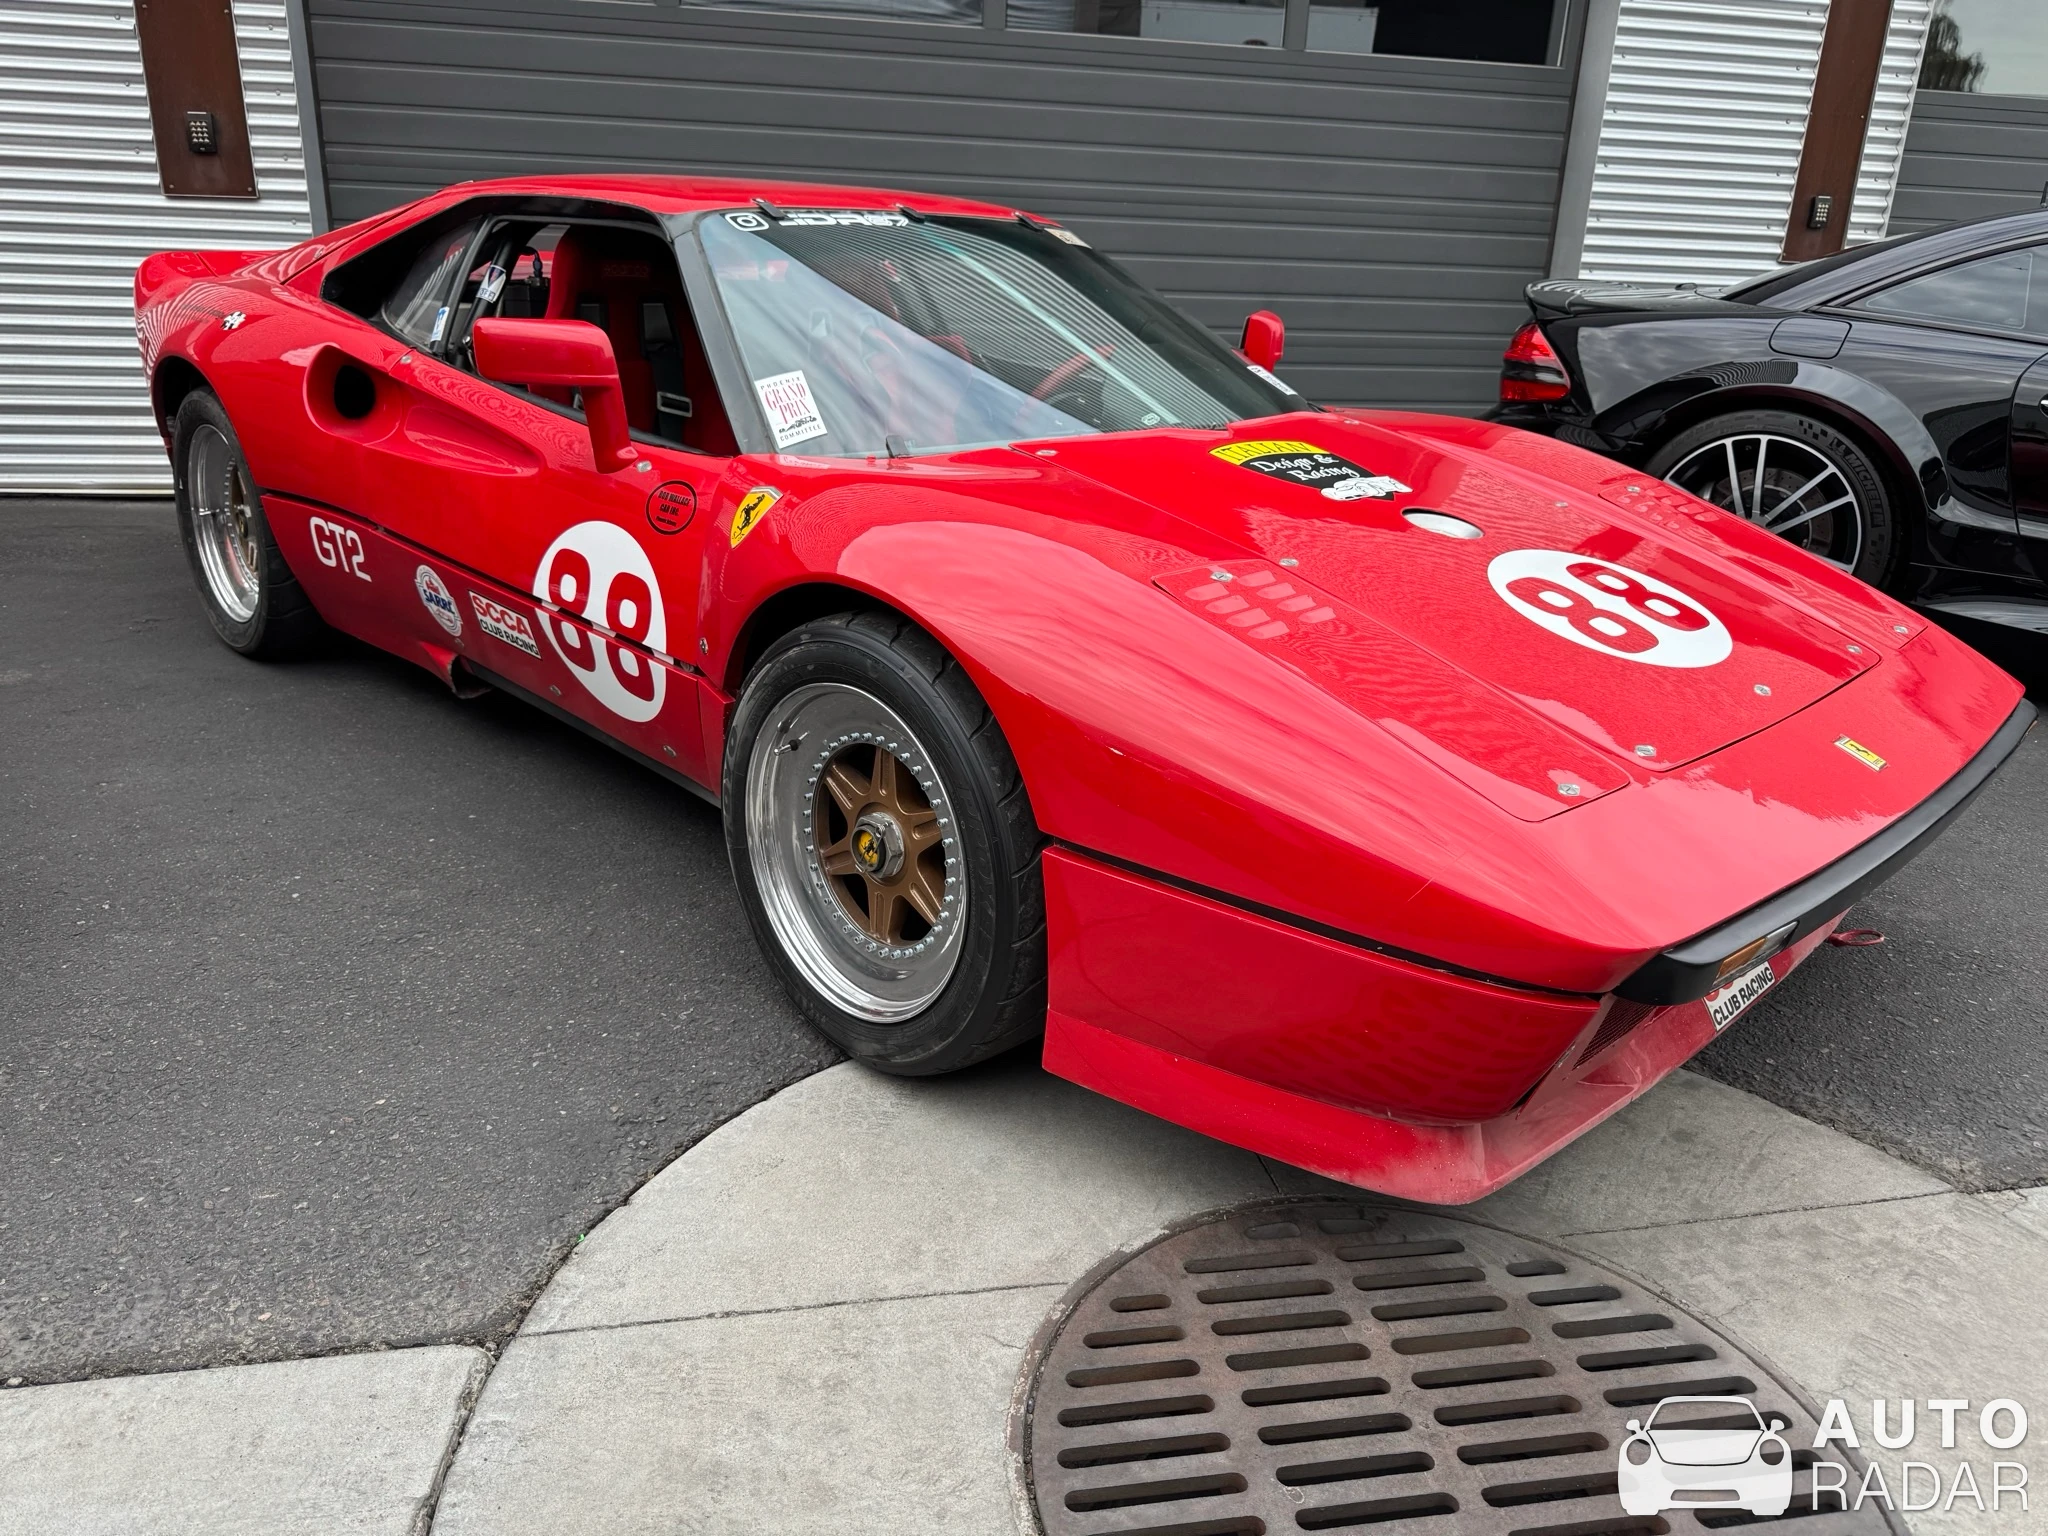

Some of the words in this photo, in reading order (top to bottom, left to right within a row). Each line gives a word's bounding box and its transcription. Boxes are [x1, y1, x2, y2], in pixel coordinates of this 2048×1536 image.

[760, 376, 801, 391] PHOENIX
[764, 383, 806, 411] GRAND
[779, 399, 811, 424] PRIX
[779, 423, 822, 442] COMMITTEE
[1215, 441, 1311, 462] ITALIAN
[1250, 457, 1316, 473] Design
[1312, 453, 1339, 465] &
[1286, 464, 1361, 482] Racing
[1844, 452, 1885, 527] MICHELIN
[310, 516, 372, 583] GT2
[471, 595, 534, 641] SCCA
[1505, 562, 1711, 654] 88
[480, 619, 505, 638] CLUB
[503, 631, 540, 656] RACING
[548, 548, 655, 703] 88
[1712, 993, 1743, 1026] CLUB
[1737, 965, 1775, 1006] RACING
